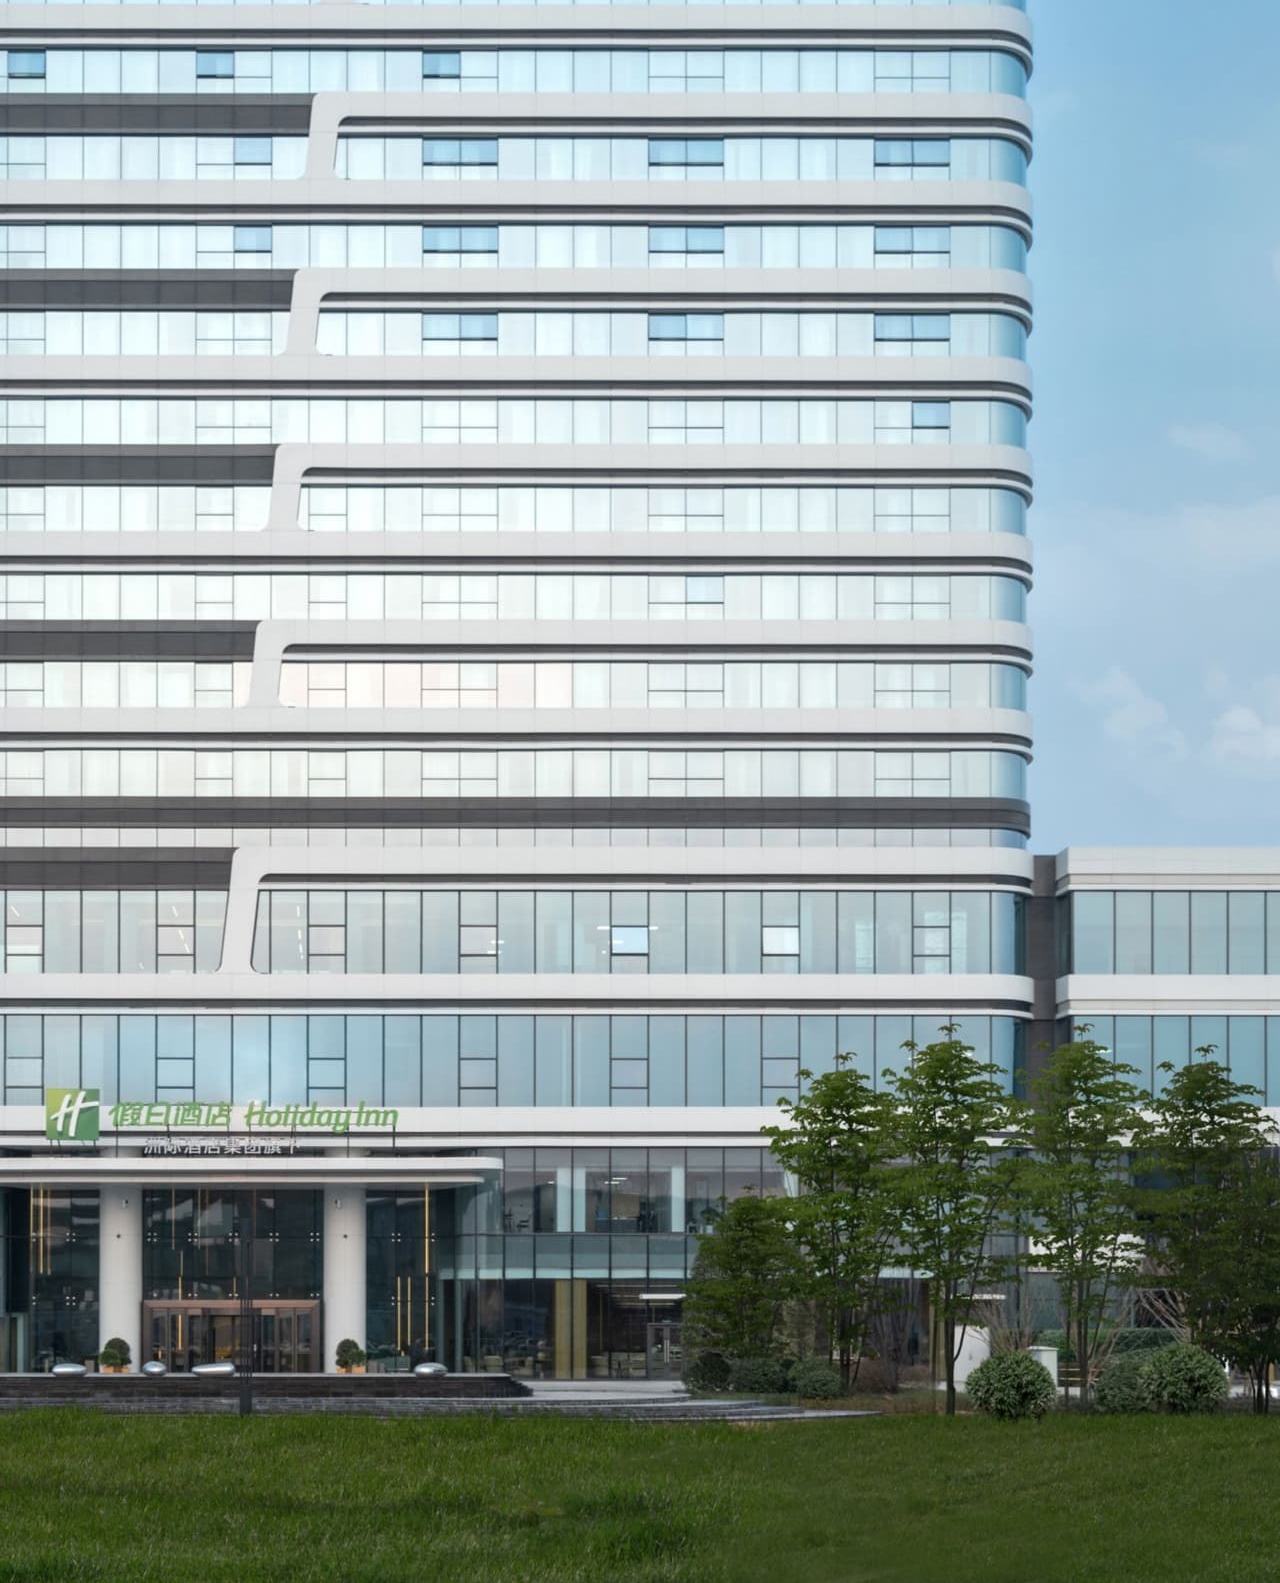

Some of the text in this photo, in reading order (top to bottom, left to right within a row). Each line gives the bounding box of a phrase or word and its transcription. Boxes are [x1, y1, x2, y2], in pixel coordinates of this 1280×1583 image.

[108, 1100, 233, 1127] 假日酒店
[244, 1100, 399, 1134] Holiday Inn
